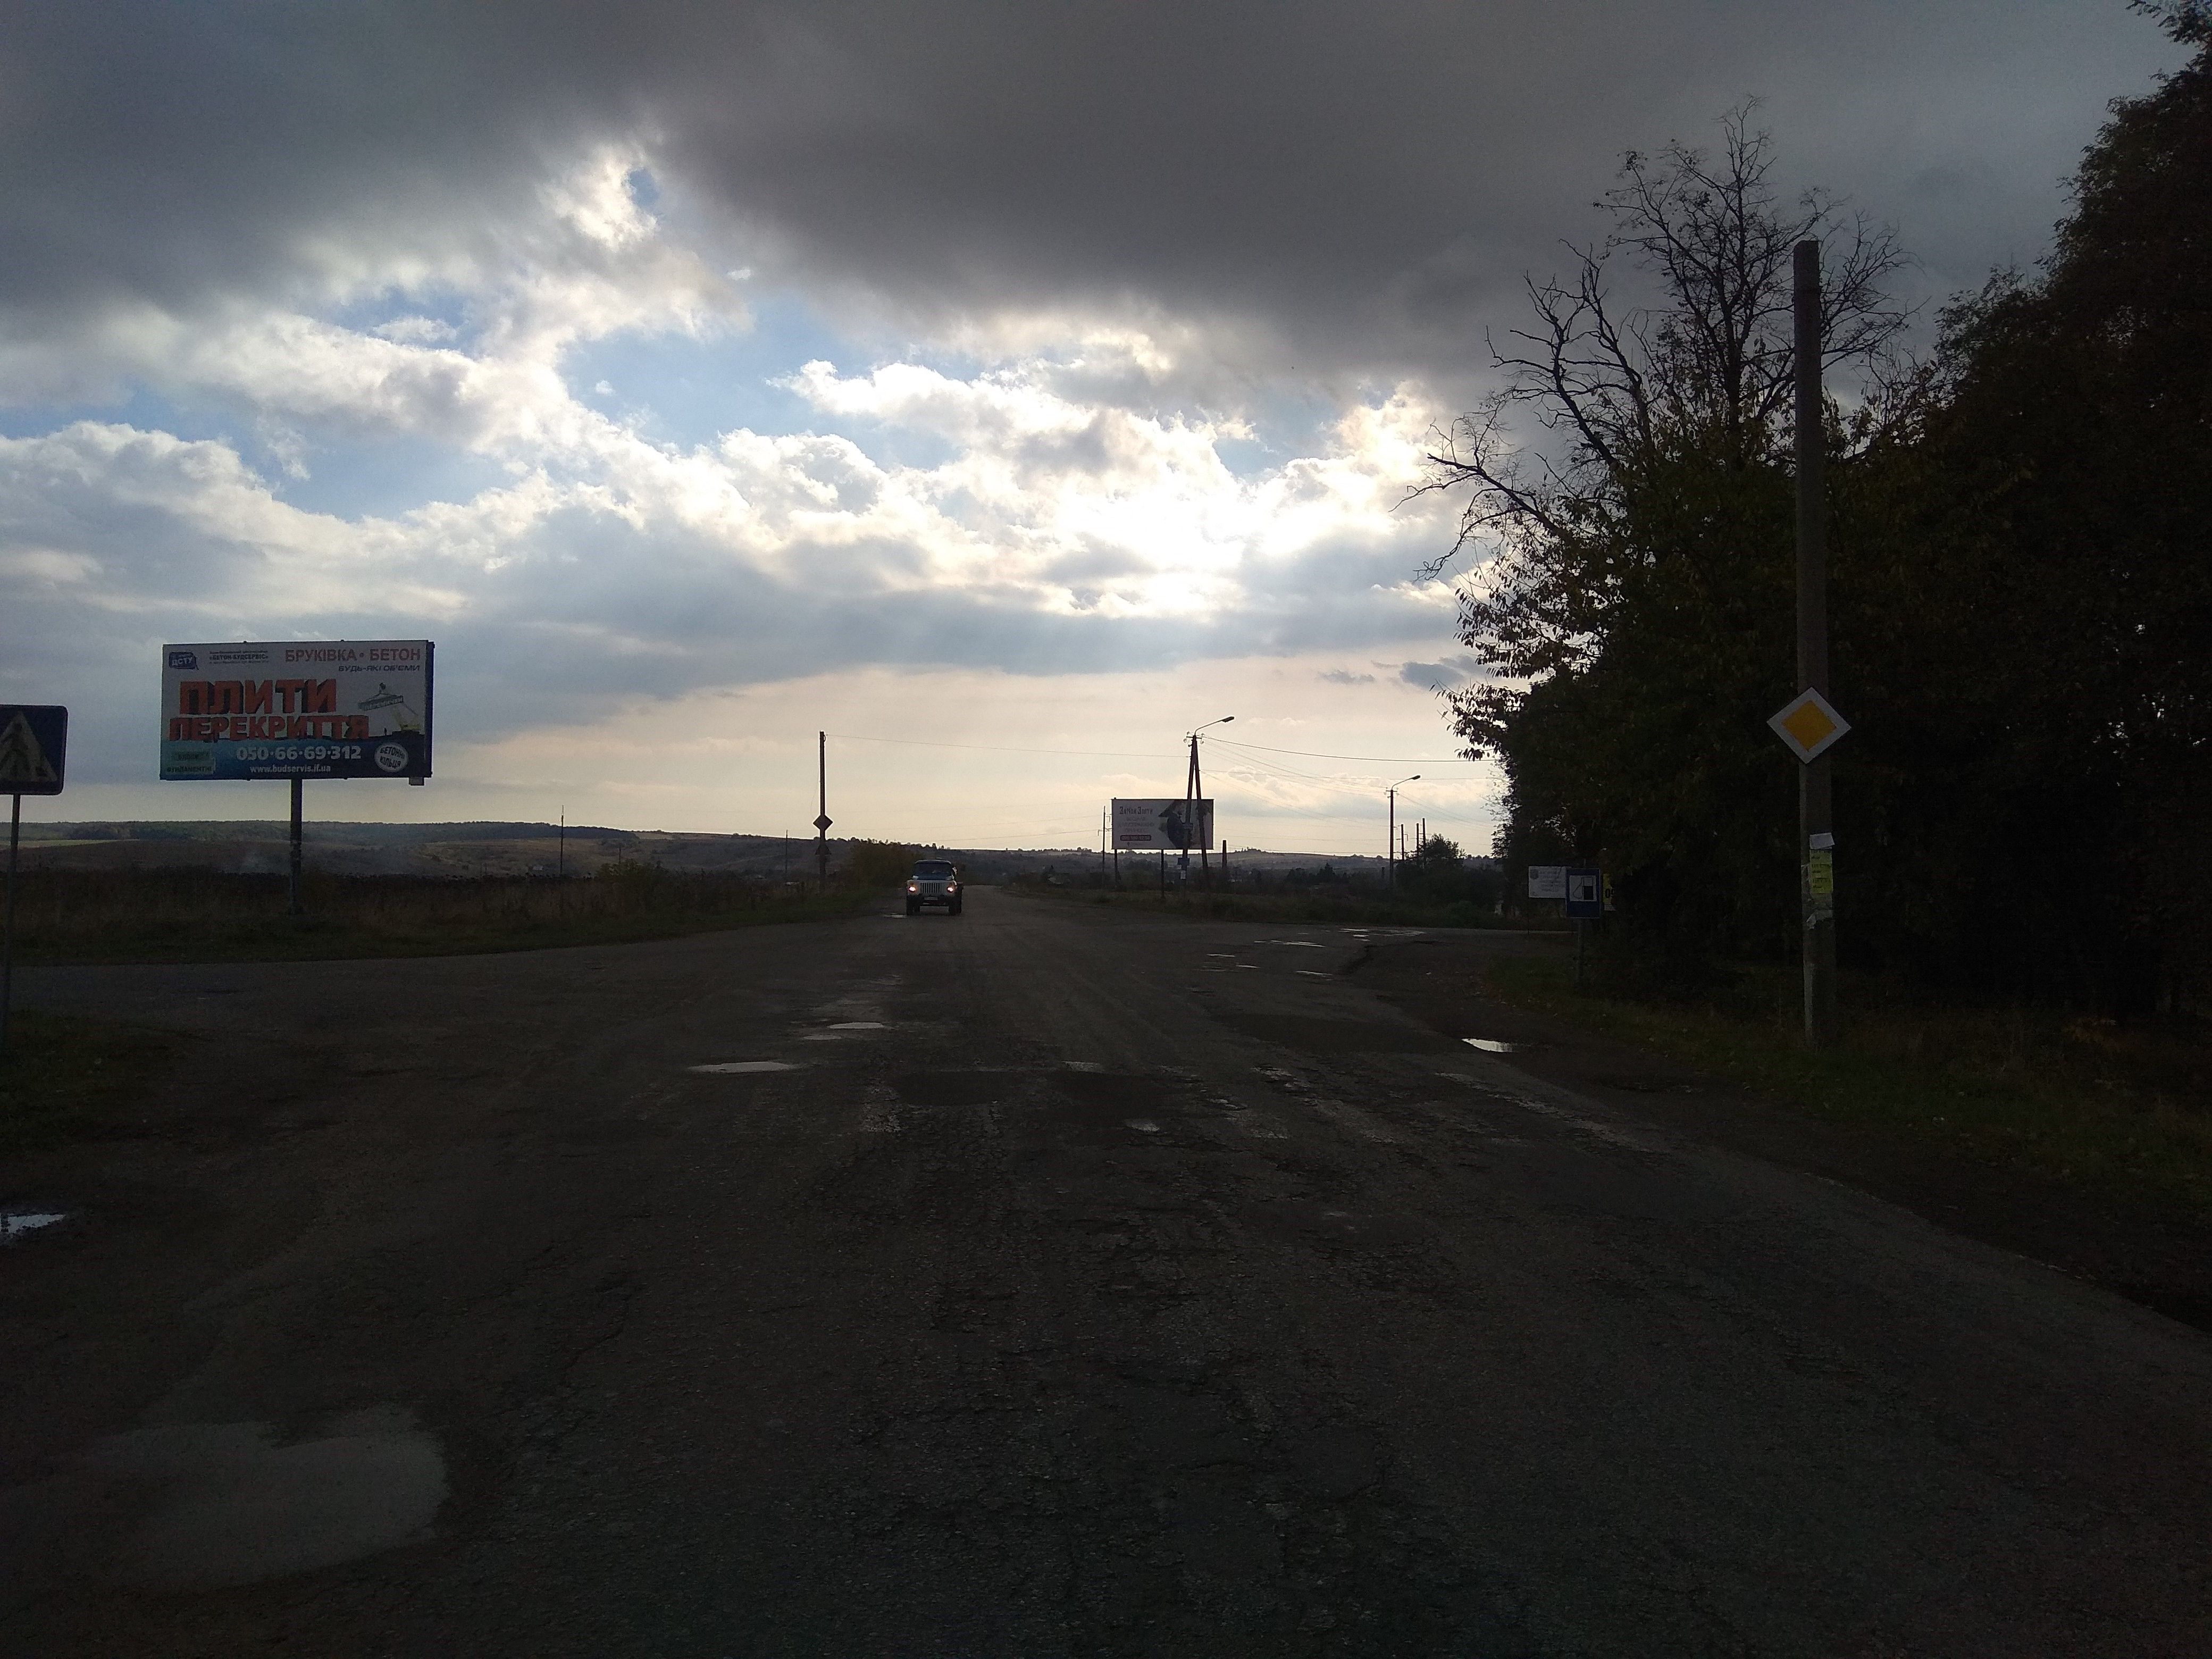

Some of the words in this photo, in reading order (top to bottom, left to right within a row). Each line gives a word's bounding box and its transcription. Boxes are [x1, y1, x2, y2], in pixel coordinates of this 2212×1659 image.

[285, 649, 357, 661] БРУКІВКА
[370, 648, 420, 661] БЕТОН
[180, 679, 336, 715] ПЛИТИ
[170, 715, 369, 742] ПЕРЕКРИТТЯ
[250, 764, 331, 773] www.budservis.if.ua
